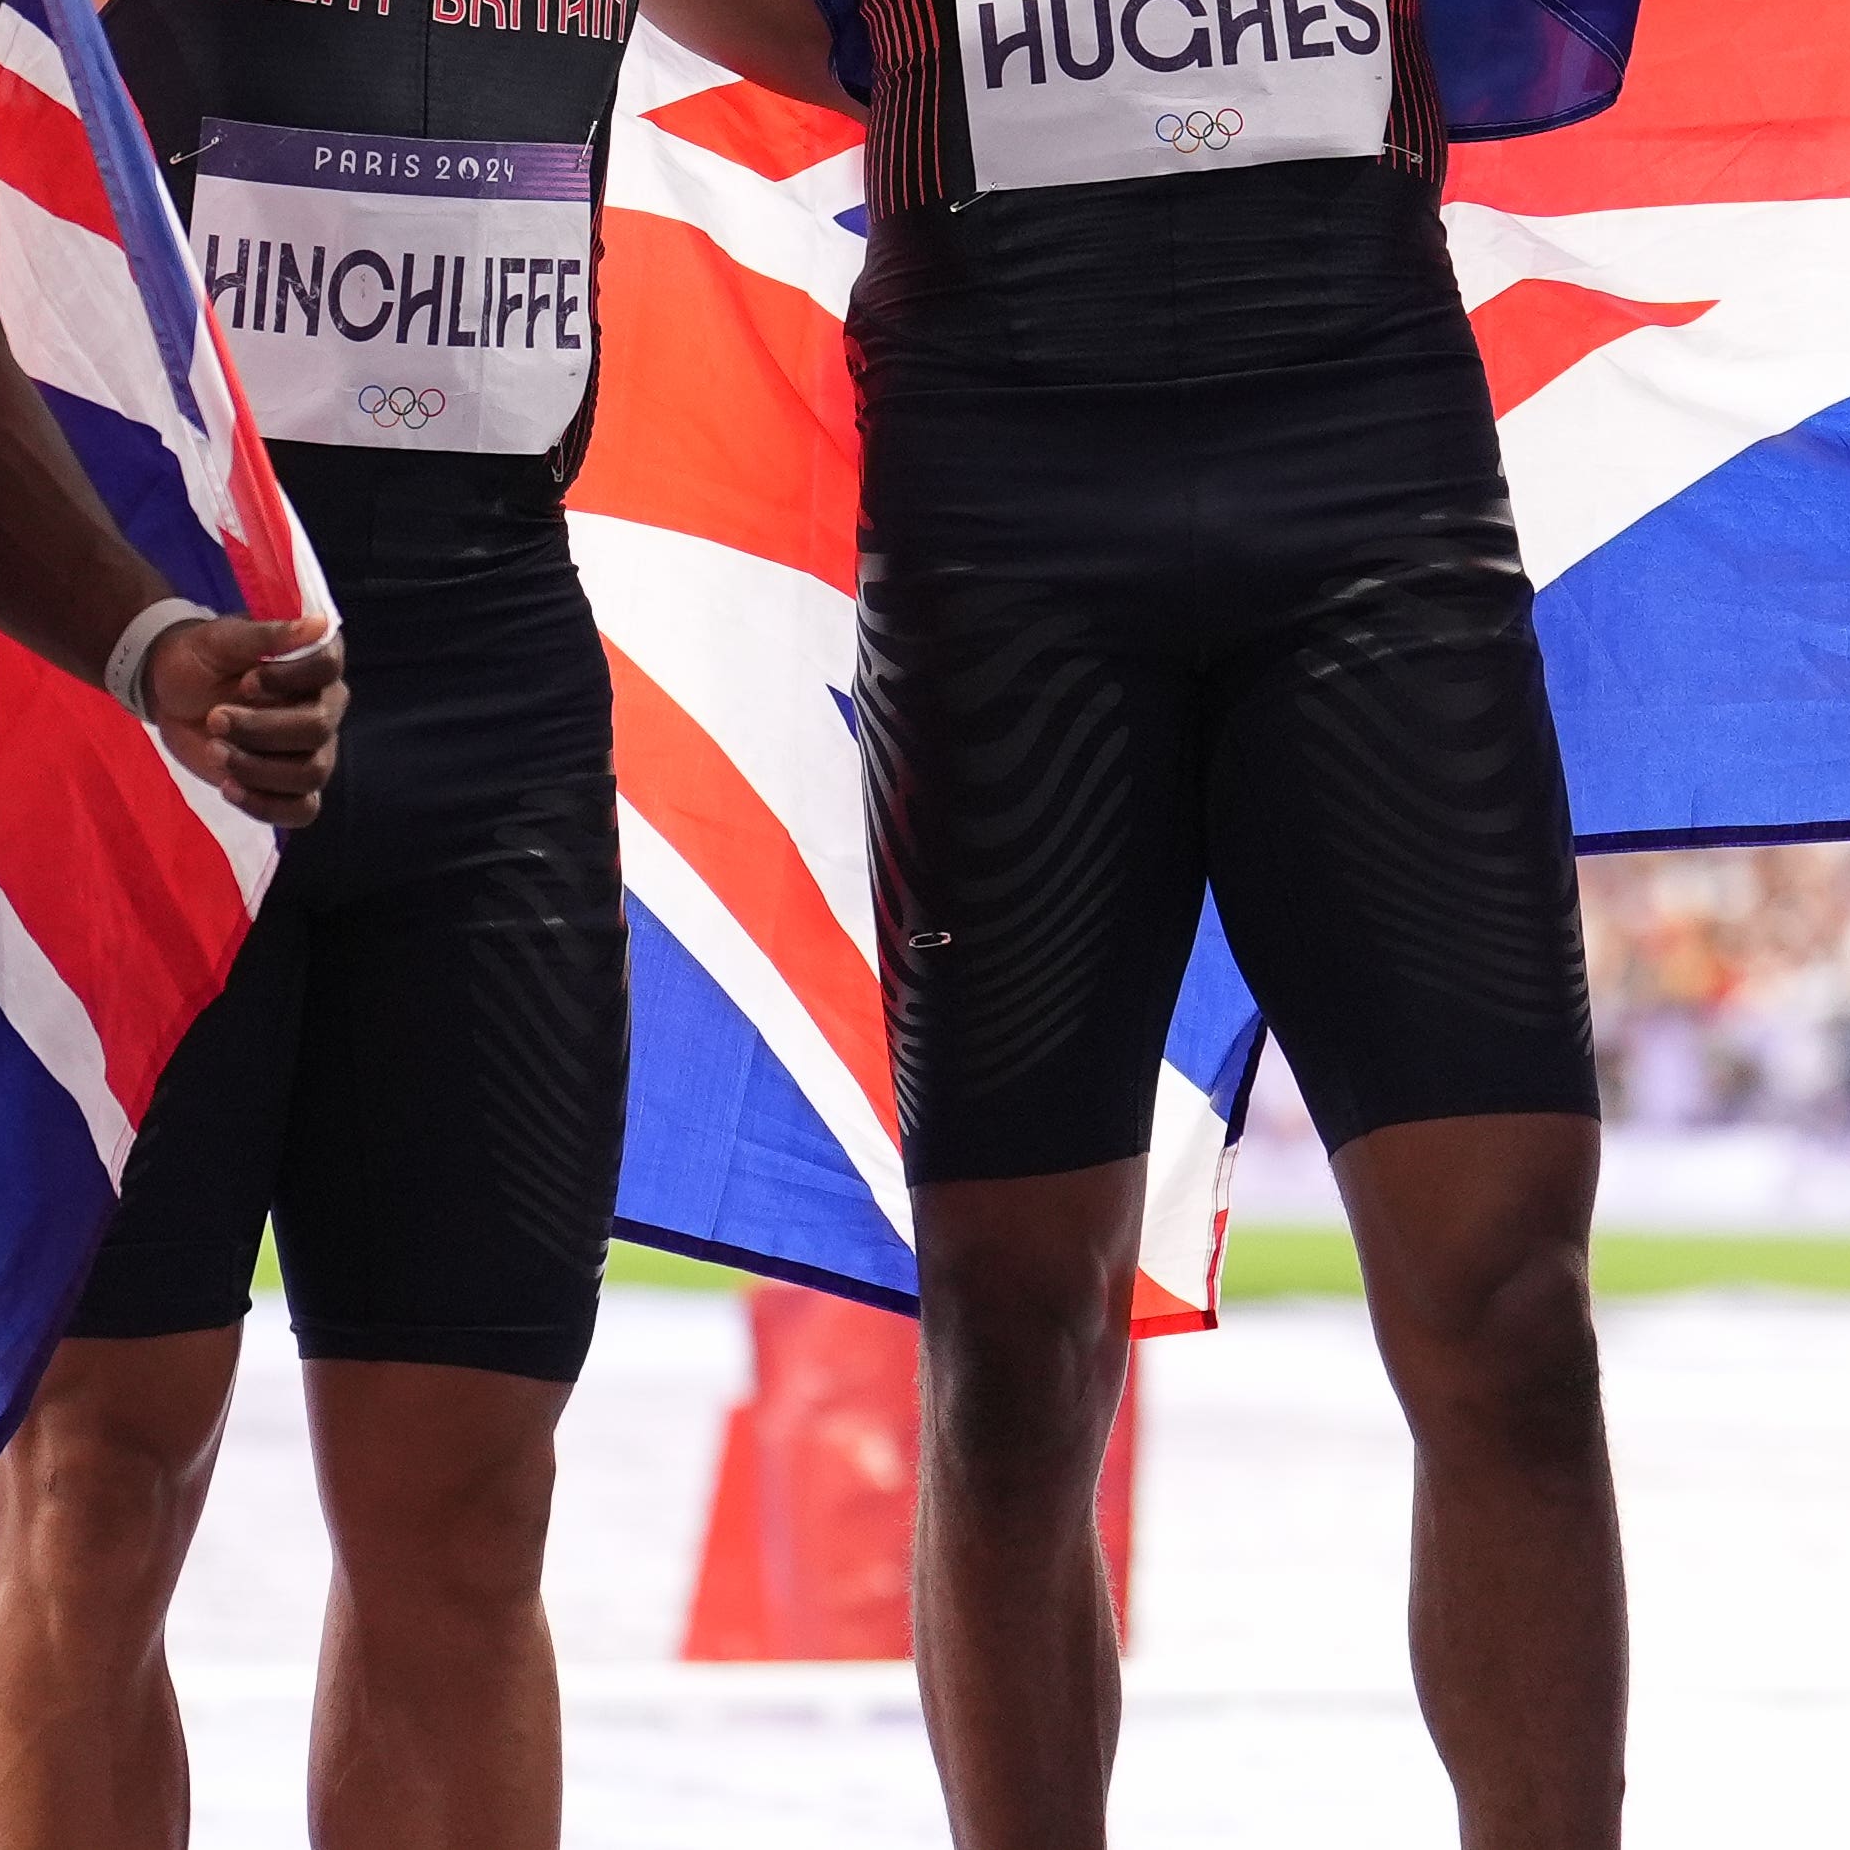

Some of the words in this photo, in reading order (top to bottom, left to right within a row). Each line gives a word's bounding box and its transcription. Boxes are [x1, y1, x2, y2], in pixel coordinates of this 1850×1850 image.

[314, 146, 420, 178] PARIS
[434, 156, 515, 183] 2024
[205, 233, 582, 350] HINCHLIFFE
